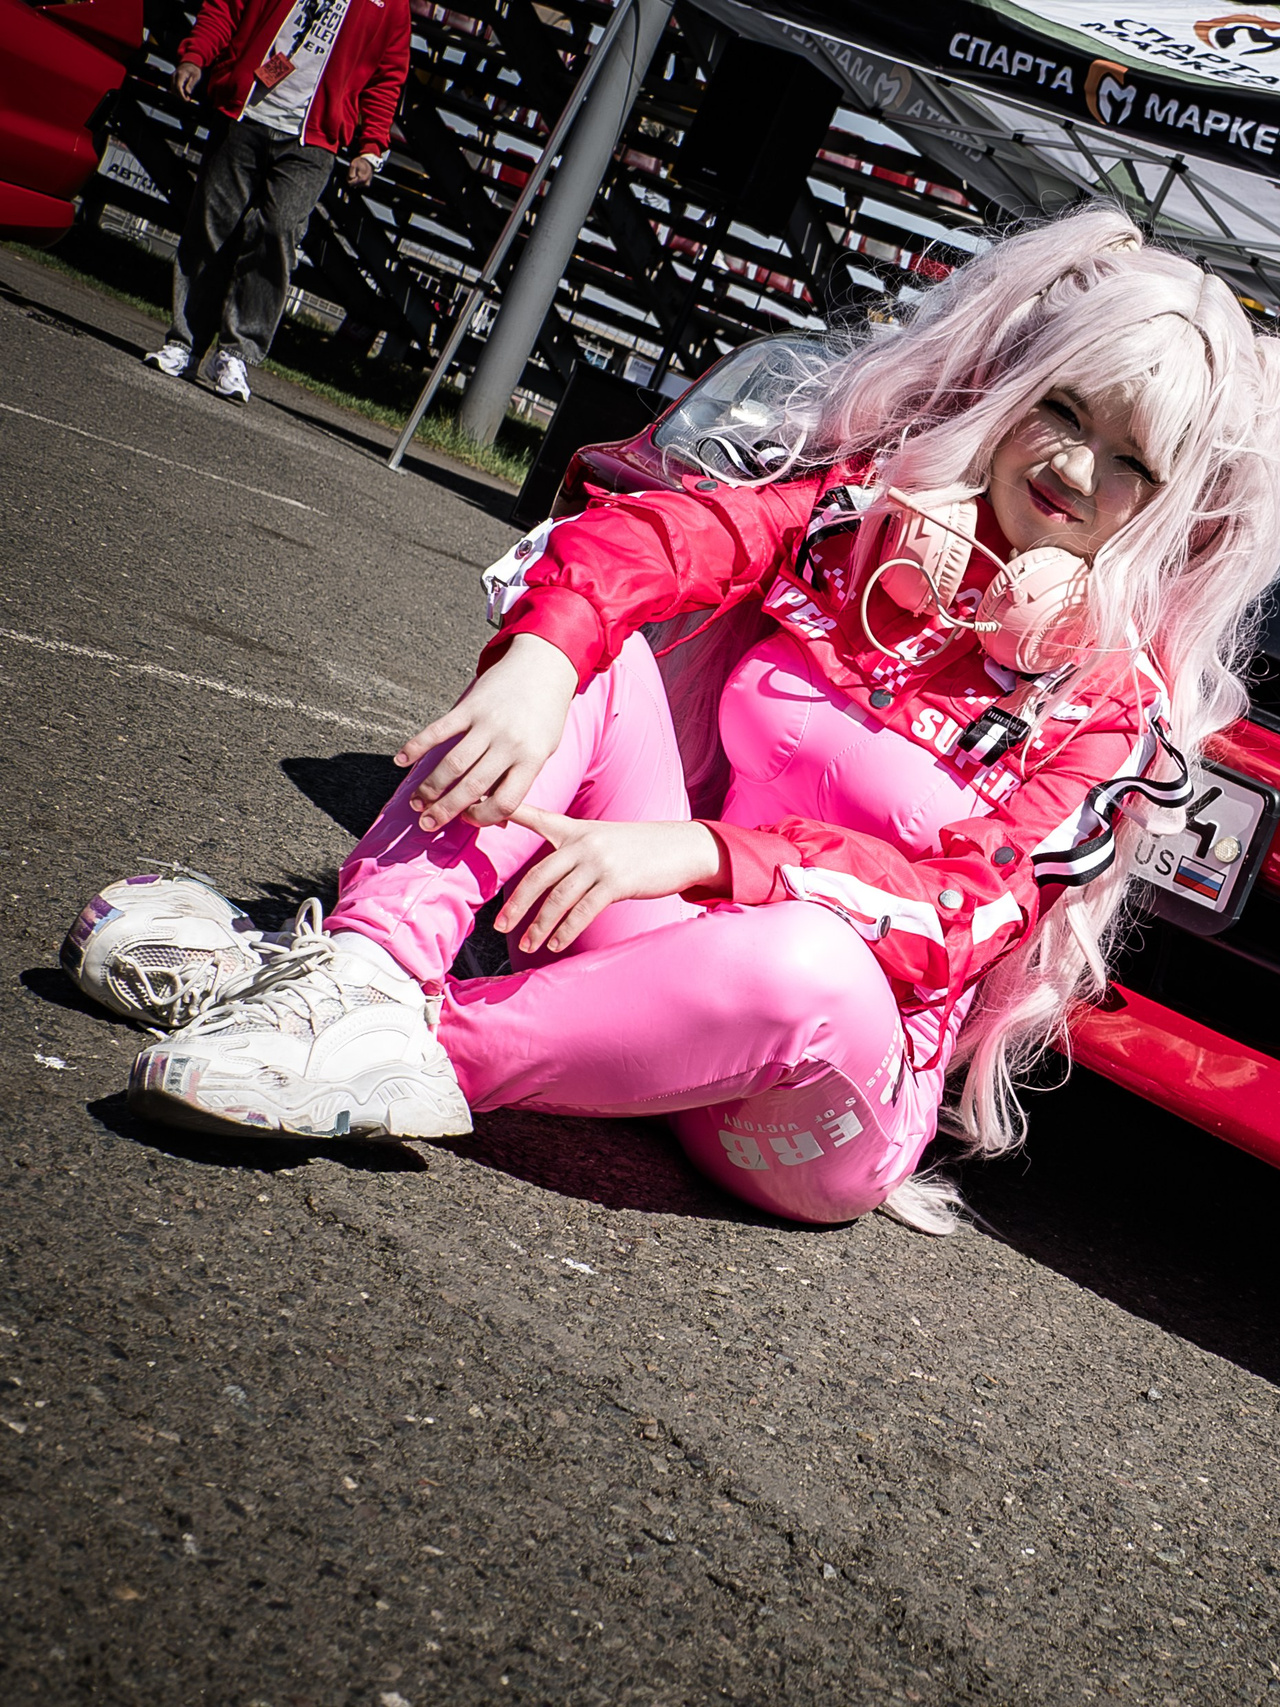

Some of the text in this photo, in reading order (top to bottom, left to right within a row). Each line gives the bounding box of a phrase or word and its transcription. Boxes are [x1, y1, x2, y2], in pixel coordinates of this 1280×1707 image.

[948, 32, 1074, 95] СПАРТА
[1114, 19, 1280, 85] СПАРТА
[1134, 838, 1175, 876] US
[723, 1112, 800, 1134] VICTORY
